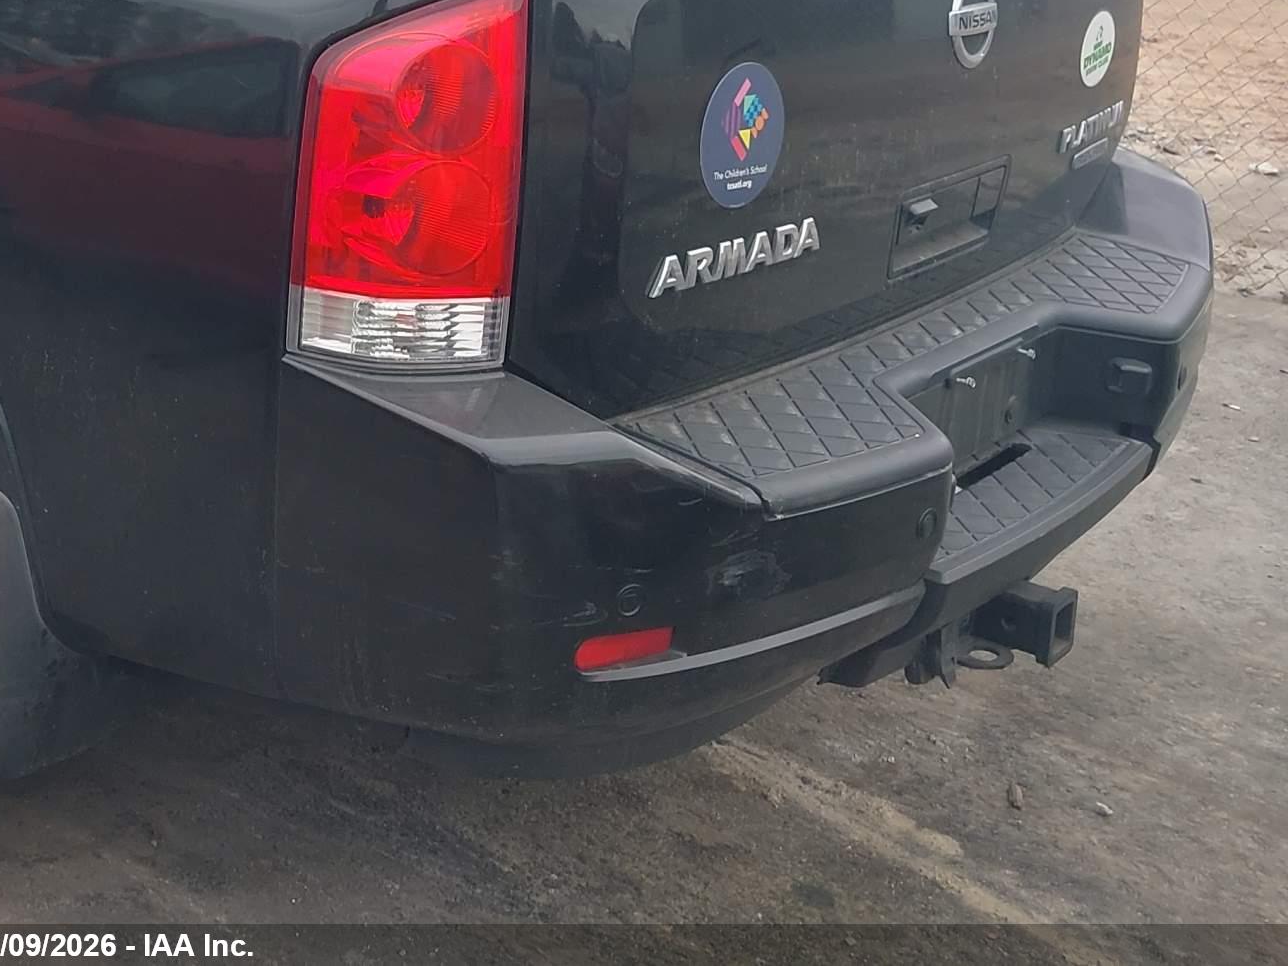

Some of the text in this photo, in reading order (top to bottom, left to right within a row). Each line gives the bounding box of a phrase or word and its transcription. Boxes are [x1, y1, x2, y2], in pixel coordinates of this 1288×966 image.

[713, 171, 724, 180] The
[750, 164, 768, 175] School
[646, 216, 821, 299] ARMADA
